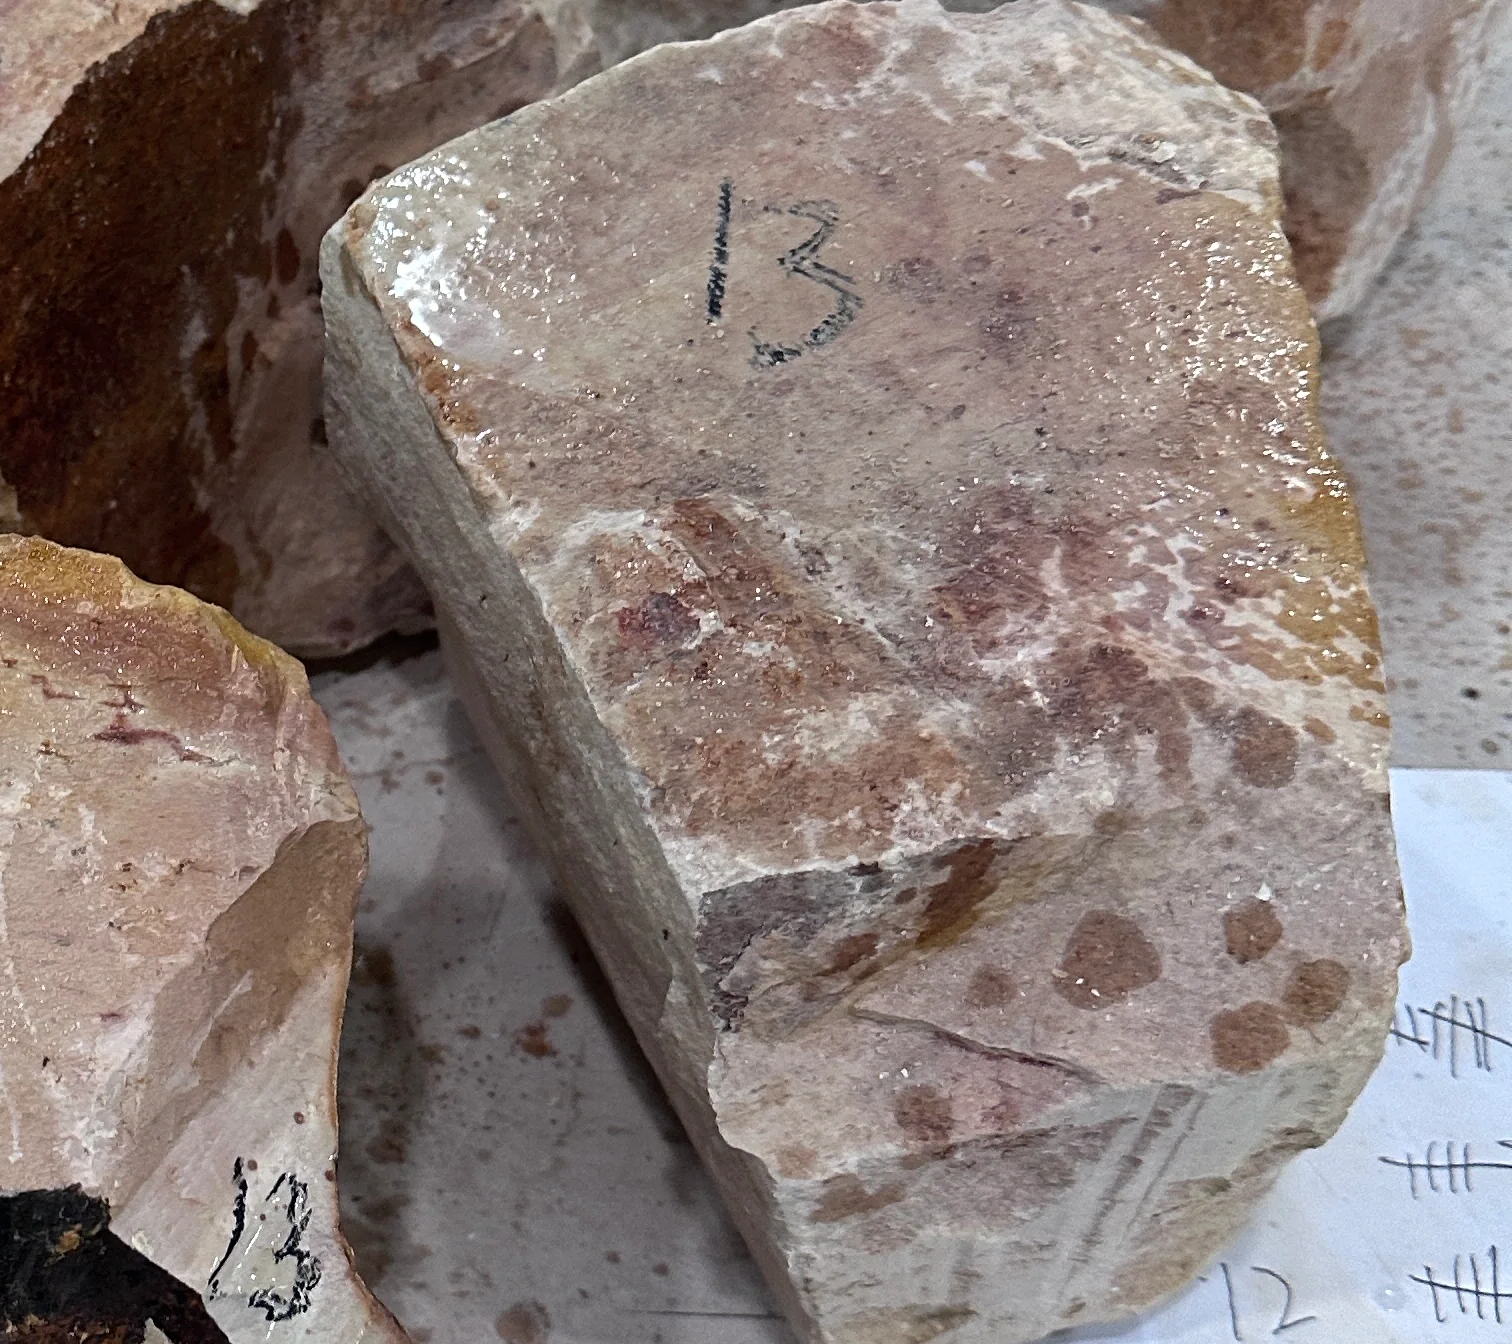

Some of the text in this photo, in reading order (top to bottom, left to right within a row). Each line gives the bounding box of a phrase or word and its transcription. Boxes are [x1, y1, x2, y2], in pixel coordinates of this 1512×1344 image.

[704, 175, 866, 367] 13
[207, 1156, 322, 1322] 13
[1220, 1262, 1317, 1342] 12
